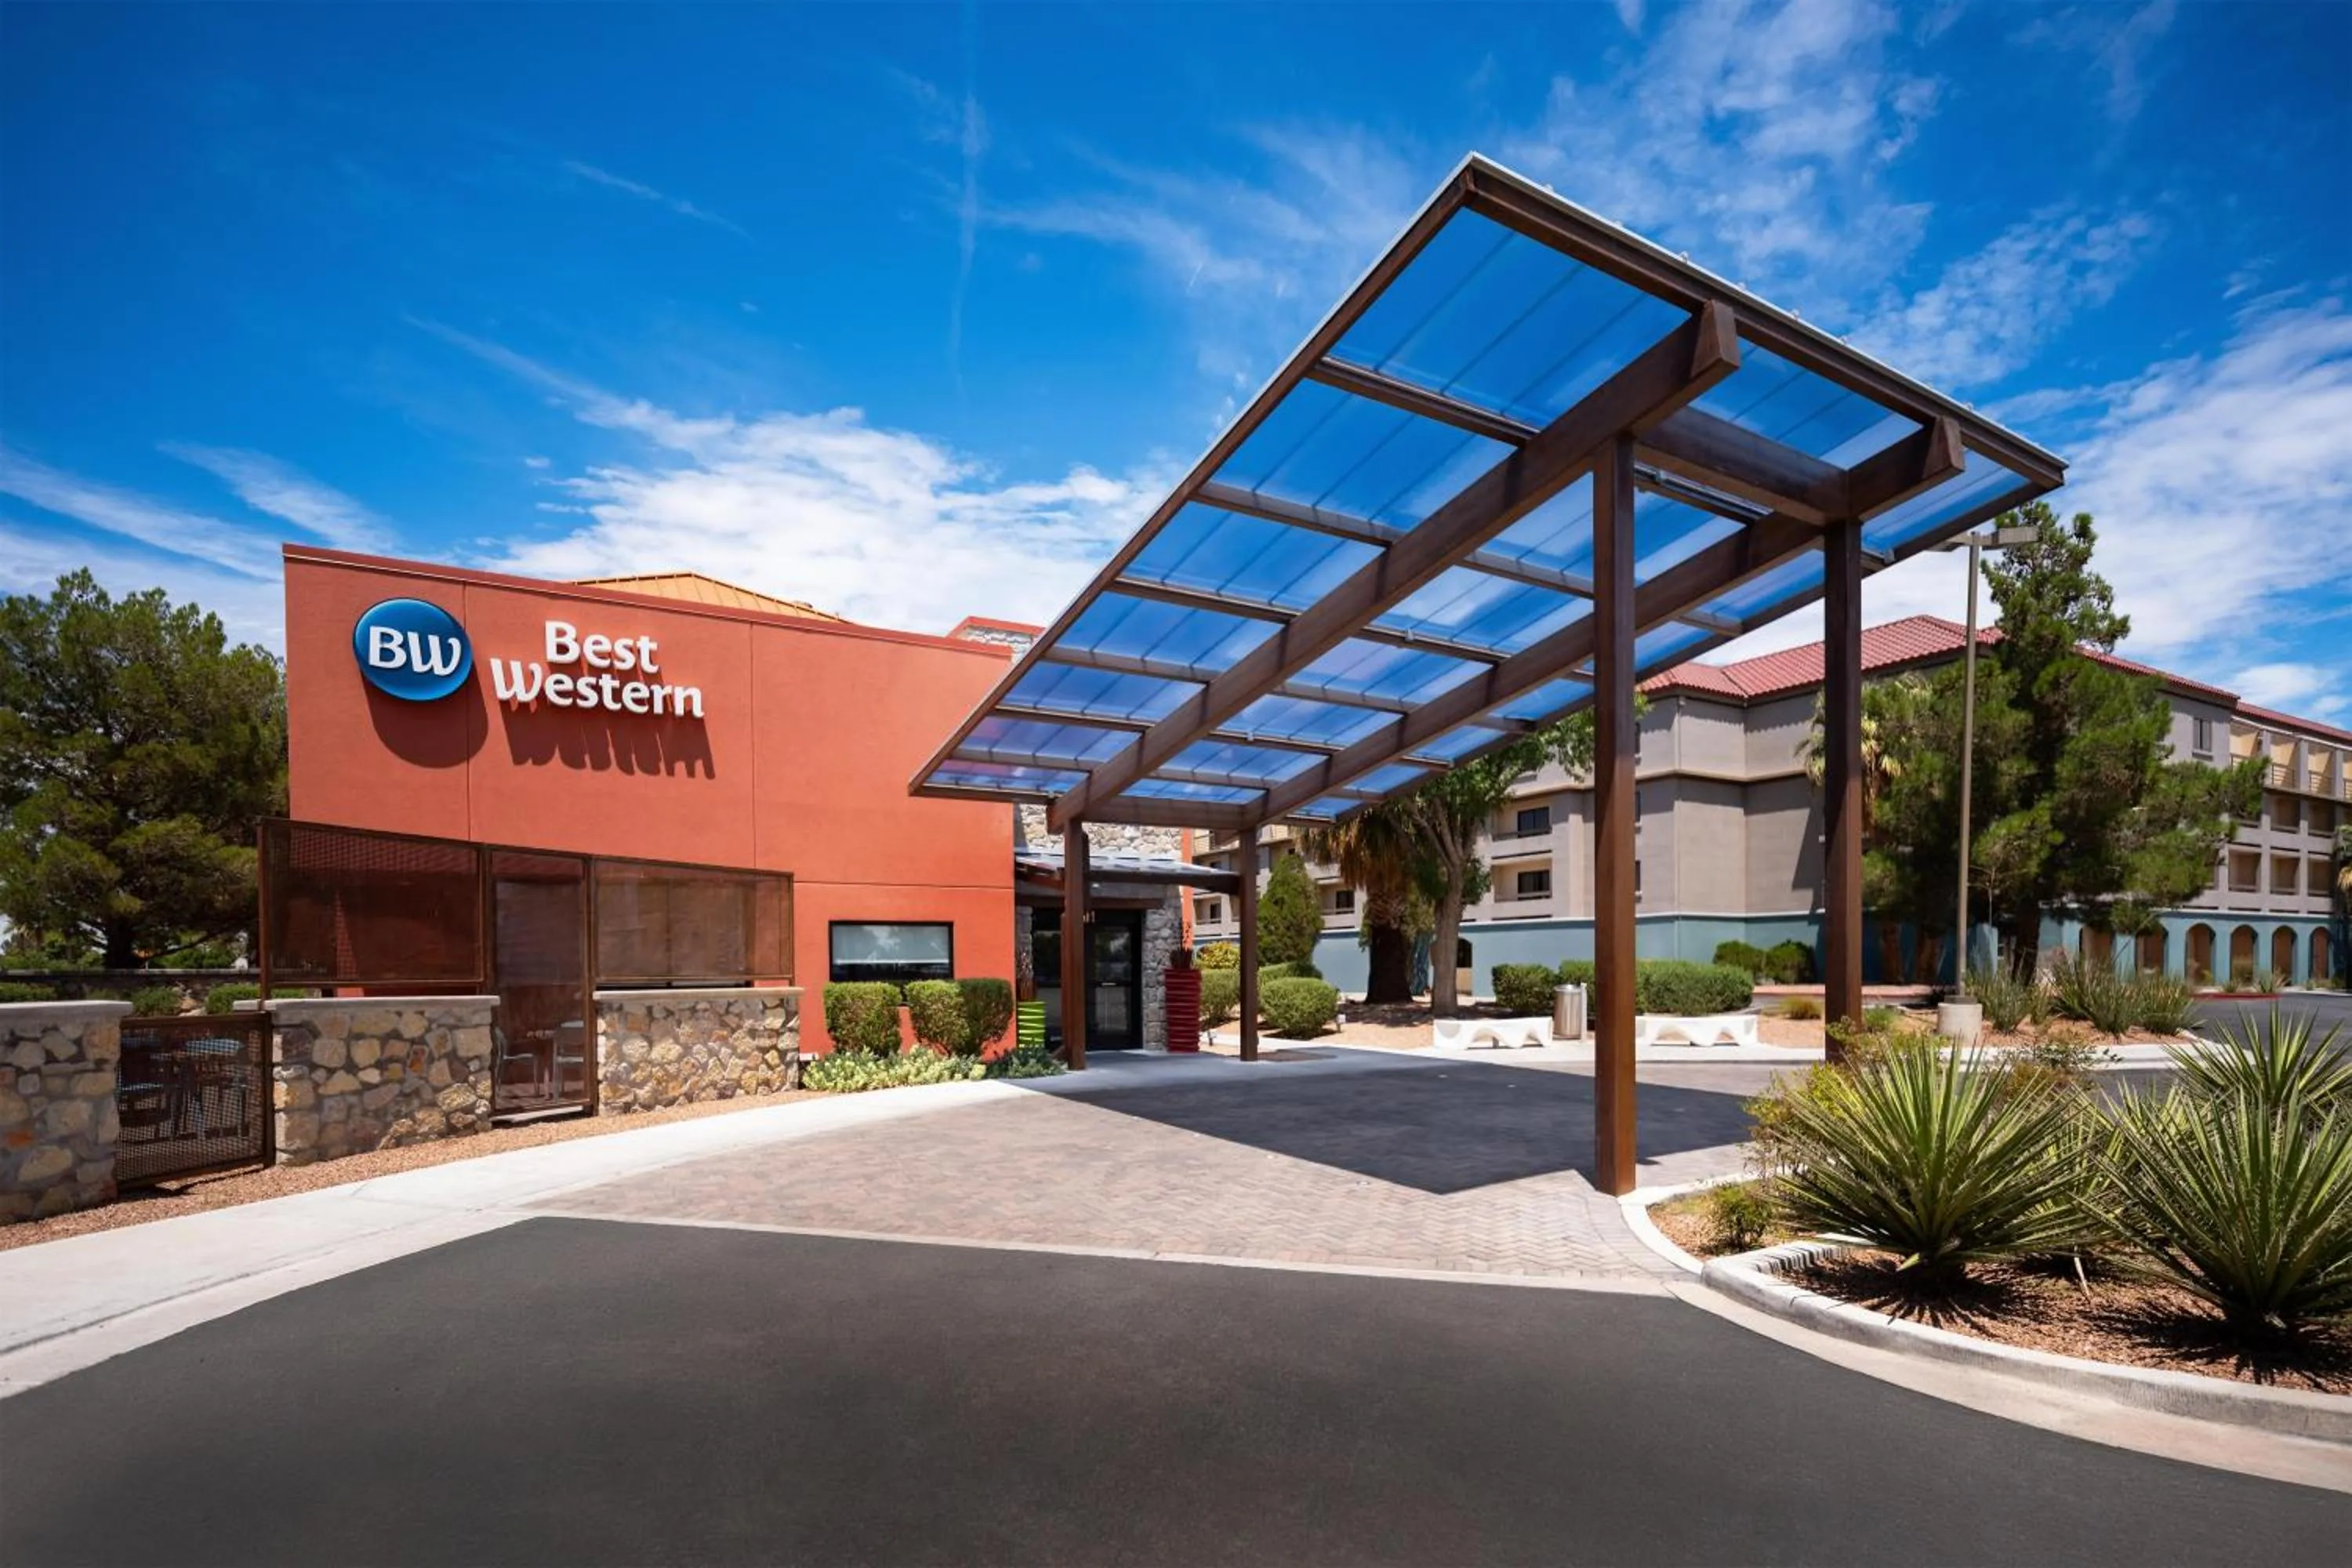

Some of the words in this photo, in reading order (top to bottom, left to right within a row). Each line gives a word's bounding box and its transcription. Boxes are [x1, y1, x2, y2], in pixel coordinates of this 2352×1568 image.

[368, 626, 462, 676] BW
[545, 620, 659, 673] Best
[490, 657, 705, 718] Western
